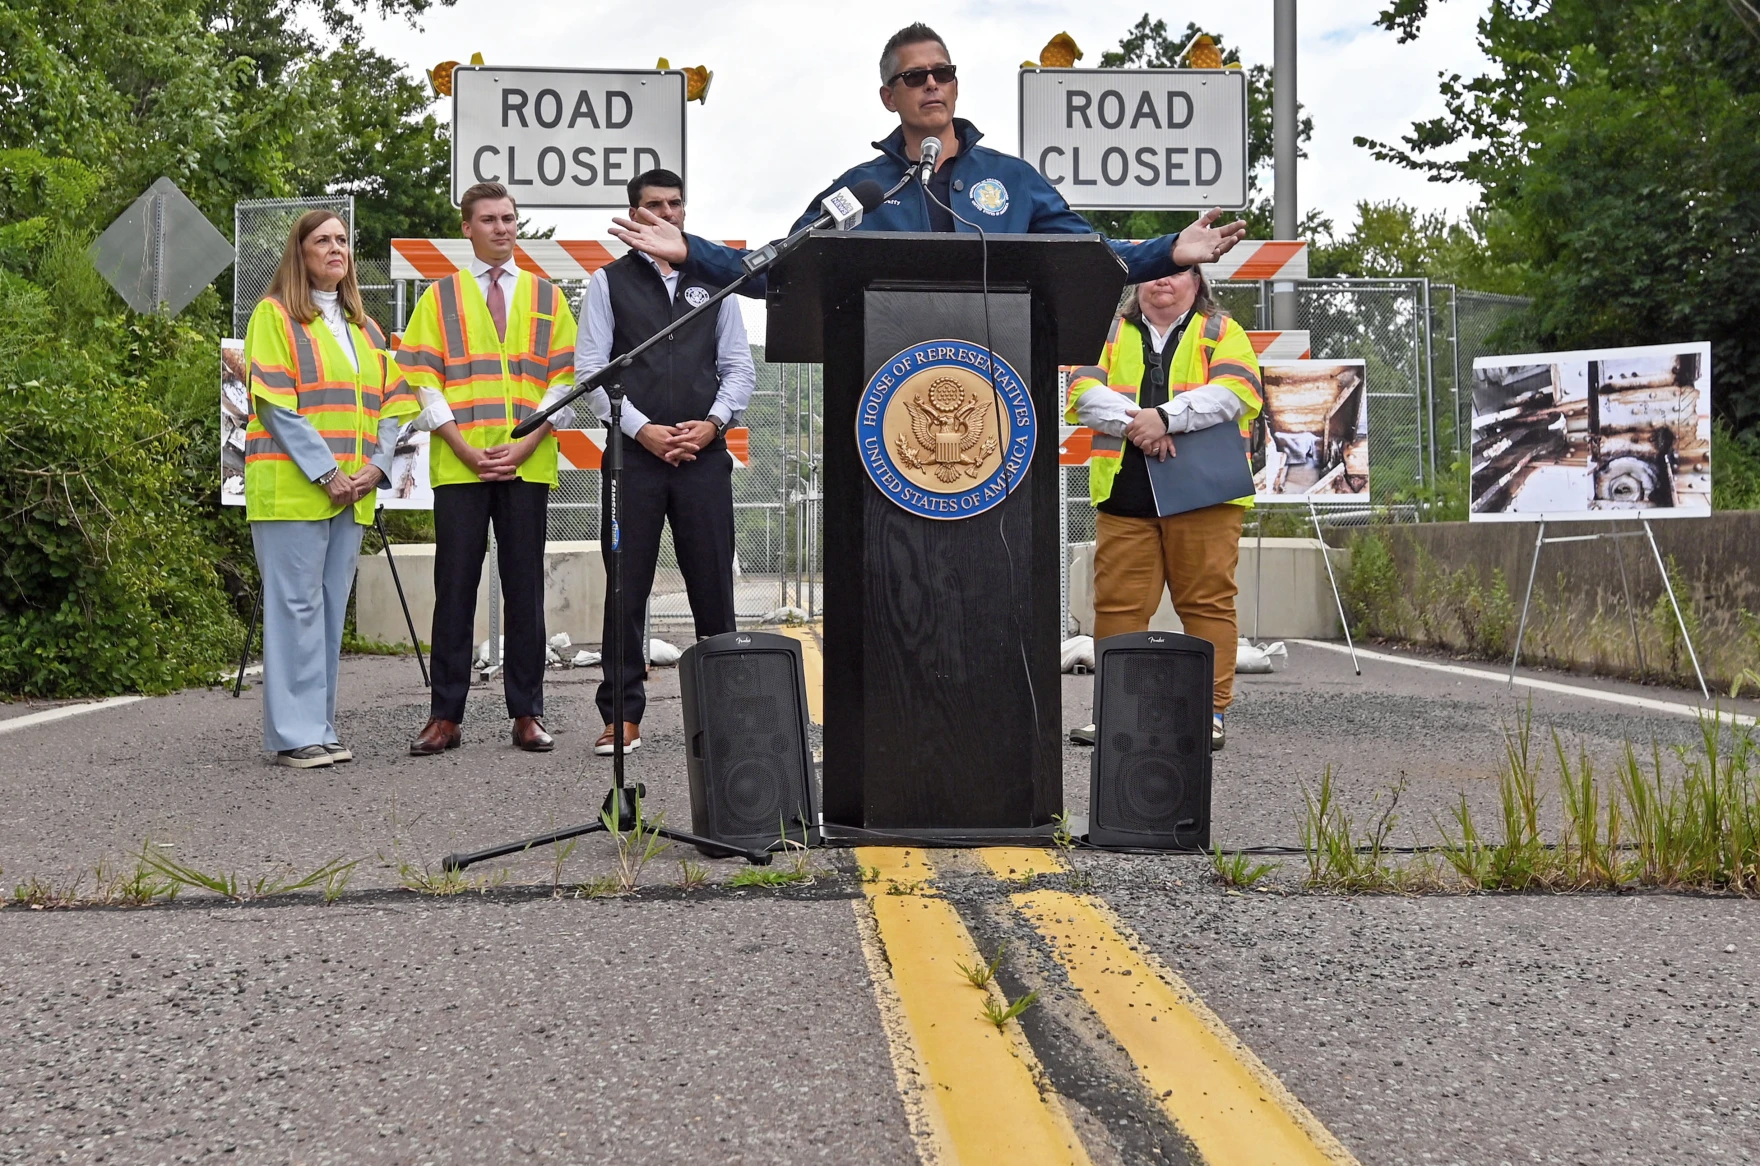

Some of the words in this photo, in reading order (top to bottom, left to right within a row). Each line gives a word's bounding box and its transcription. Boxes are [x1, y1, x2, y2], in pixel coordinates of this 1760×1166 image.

[501, 88, 633, 129] ROAD
[1066, 89, 1194, 129] ROAD
[473, 145, 661, 186] CLOSED
[1039, 146, 1222, 186] CLOSED
[831, 197, 849, 216] NEWS
[864, 373, 895, 427] HOUSE
[892, 357, 912, 376] OF
[915, 347, 1030, 427] REPRESENTATIVES
[865, 436, 902, 493] UNITED
[900, 487, 958, 512] STATES
[960, 492, 981, 510] OF
[984, 434, 1029, 501] AMERICA
